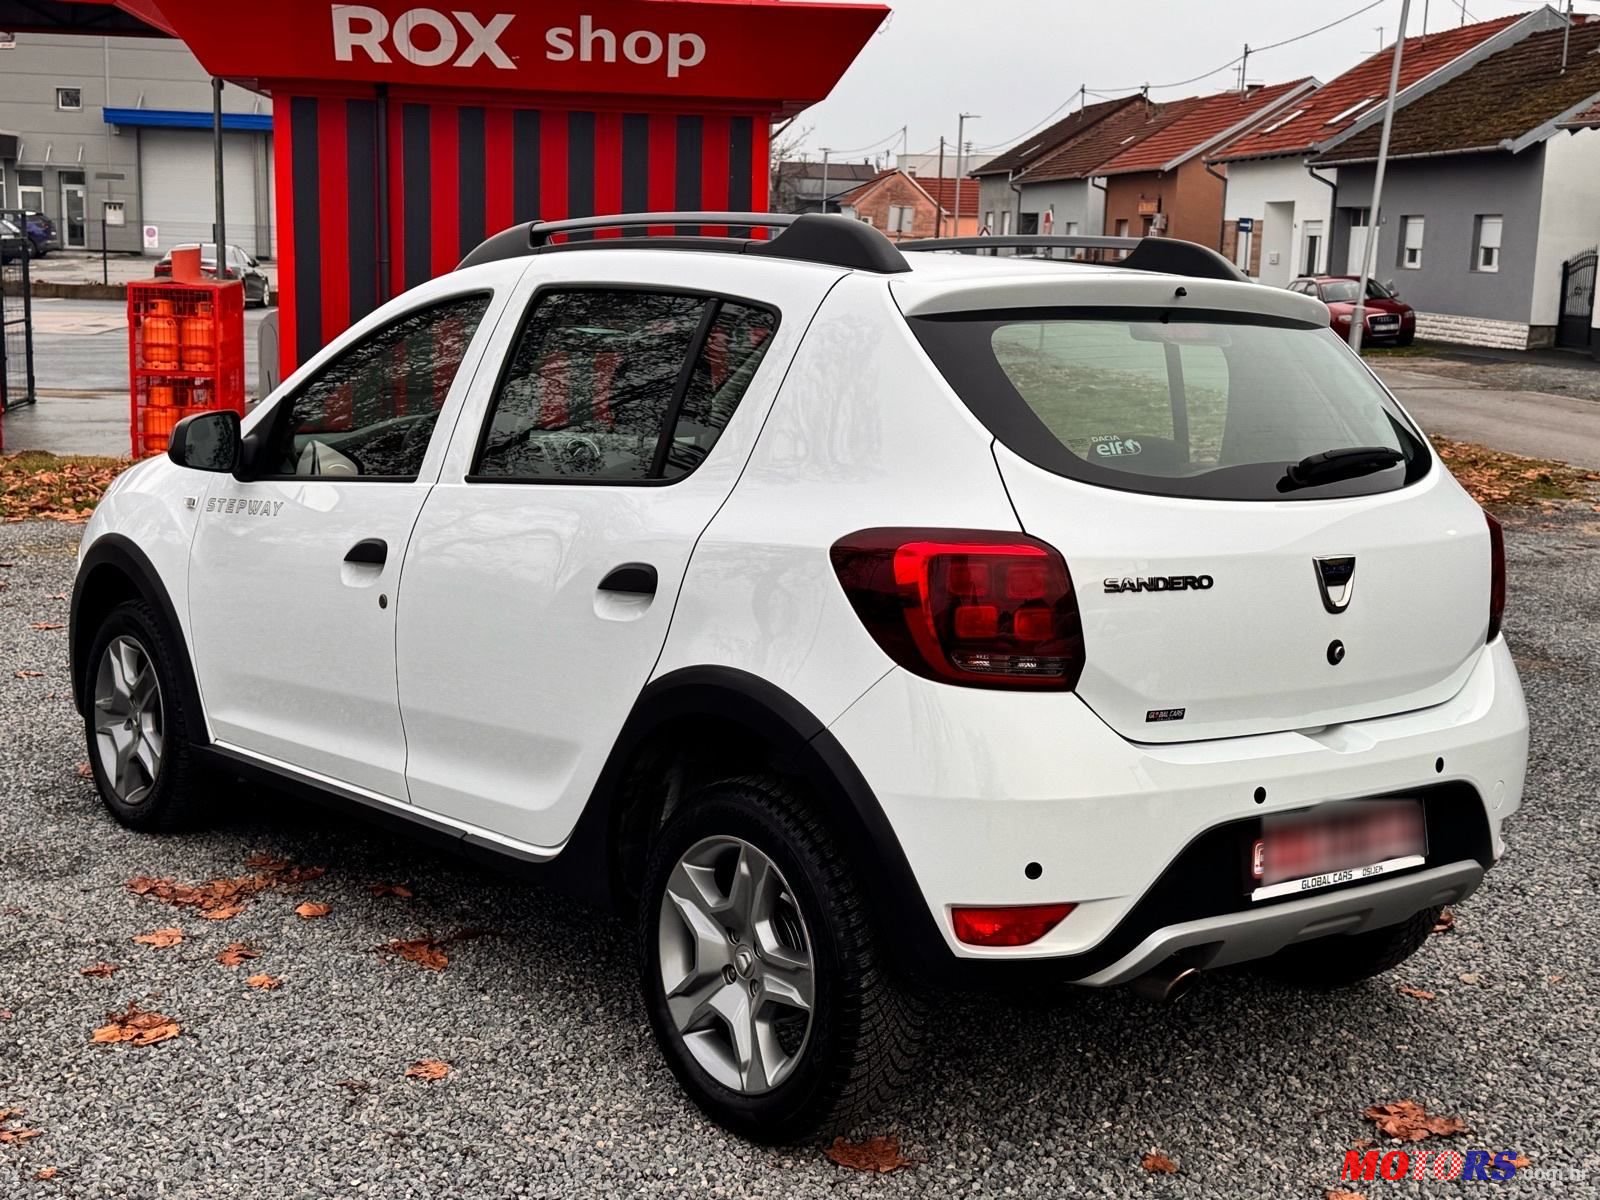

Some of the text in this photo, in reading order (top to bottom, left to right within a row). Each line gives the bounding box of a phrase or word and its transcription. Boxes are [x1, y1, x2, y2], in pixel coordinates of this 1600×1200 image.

[331, 4, 706, 77] ROX shop
[1096, 441, 1123, 455] elf
[206, 497, 284, 517] STEPWAY
[1103, 575, 1214, 593] SANDERO
[1301, 865, 1384, 889] GLOBAL CARS OSIJEK
